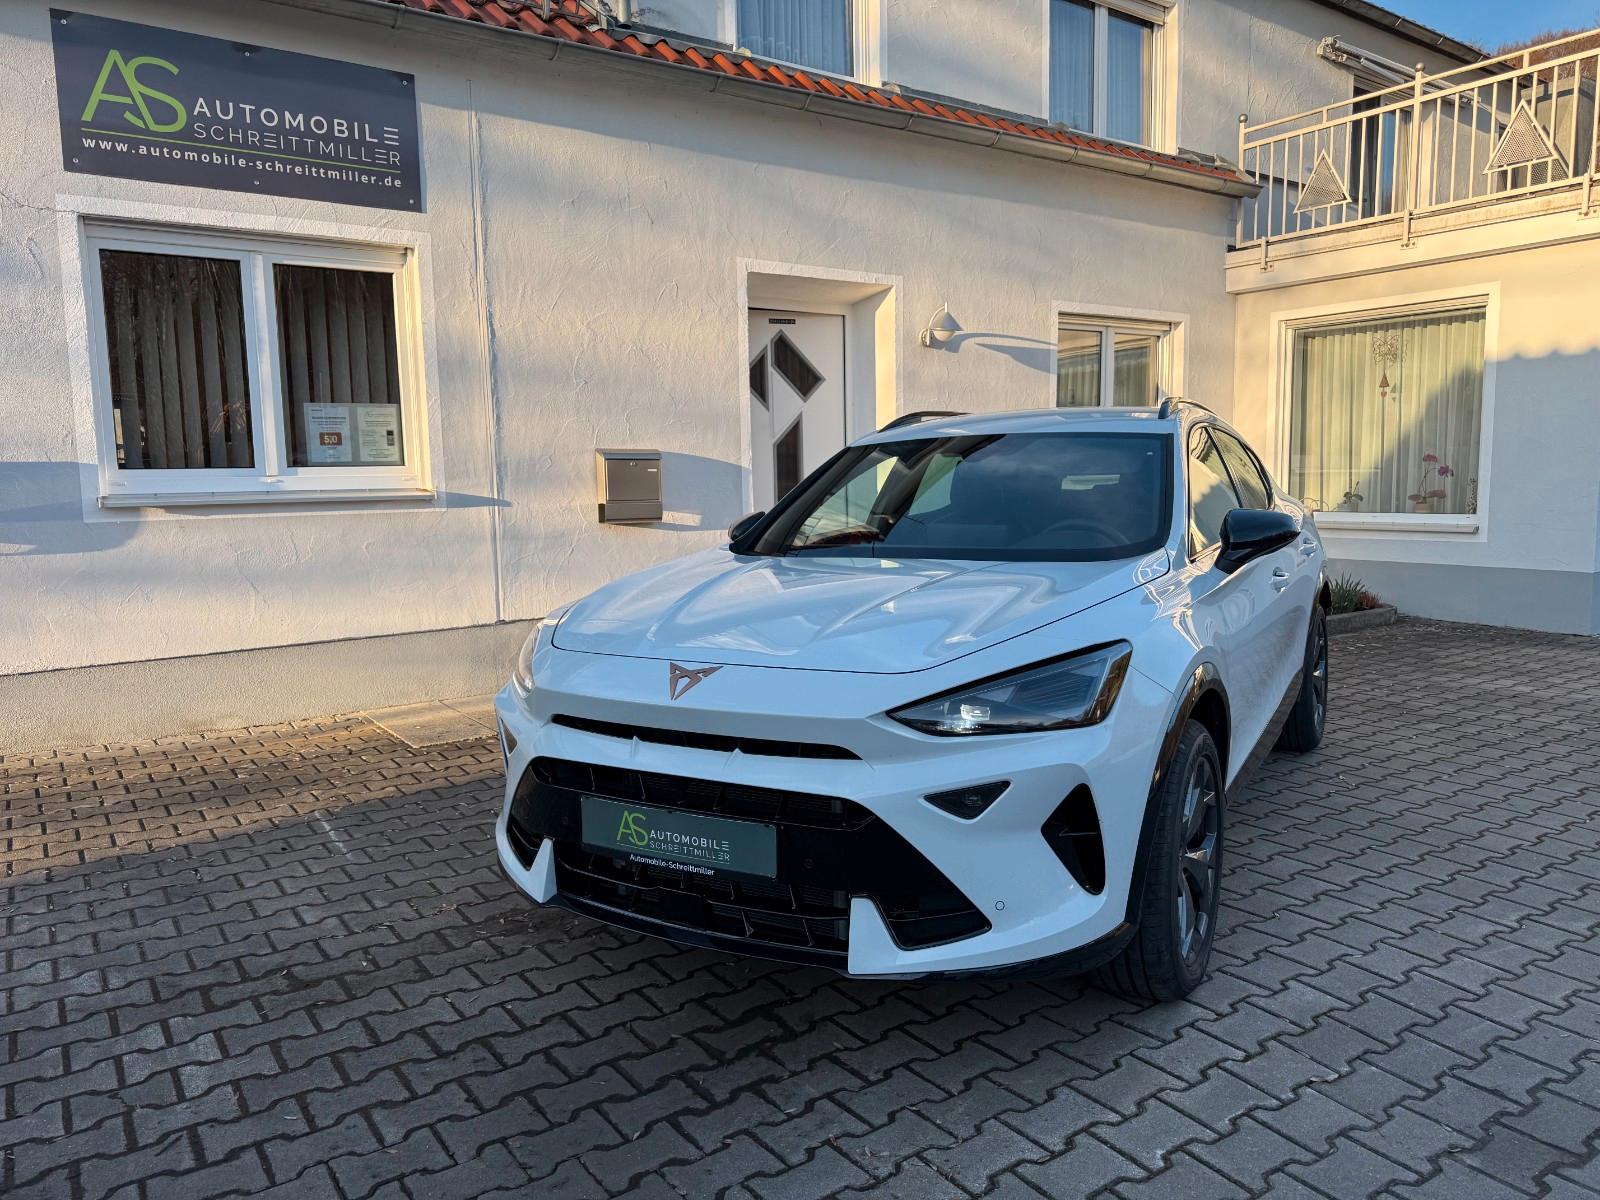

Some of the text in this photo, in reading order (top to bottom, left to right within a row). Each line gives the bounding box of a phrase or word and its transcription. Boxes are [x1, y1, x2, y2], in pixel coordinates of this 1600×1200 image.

[81, 49, 187, 133] AS
[193, 97, 399, 146] AUTOMOBILE
[82, 138, 402, 188] www.automobile-schreittmiller.de
[194, 123, 400, 166] SCHREITTMILLER
[616, 810, 648, 846] AS
[650, 830, 729, 851] AUTOMOBILE
[630, 853, 715, 876] Automobile-Schreittmiller
[650, 840, 730, 861] SCHREITTMILLER
